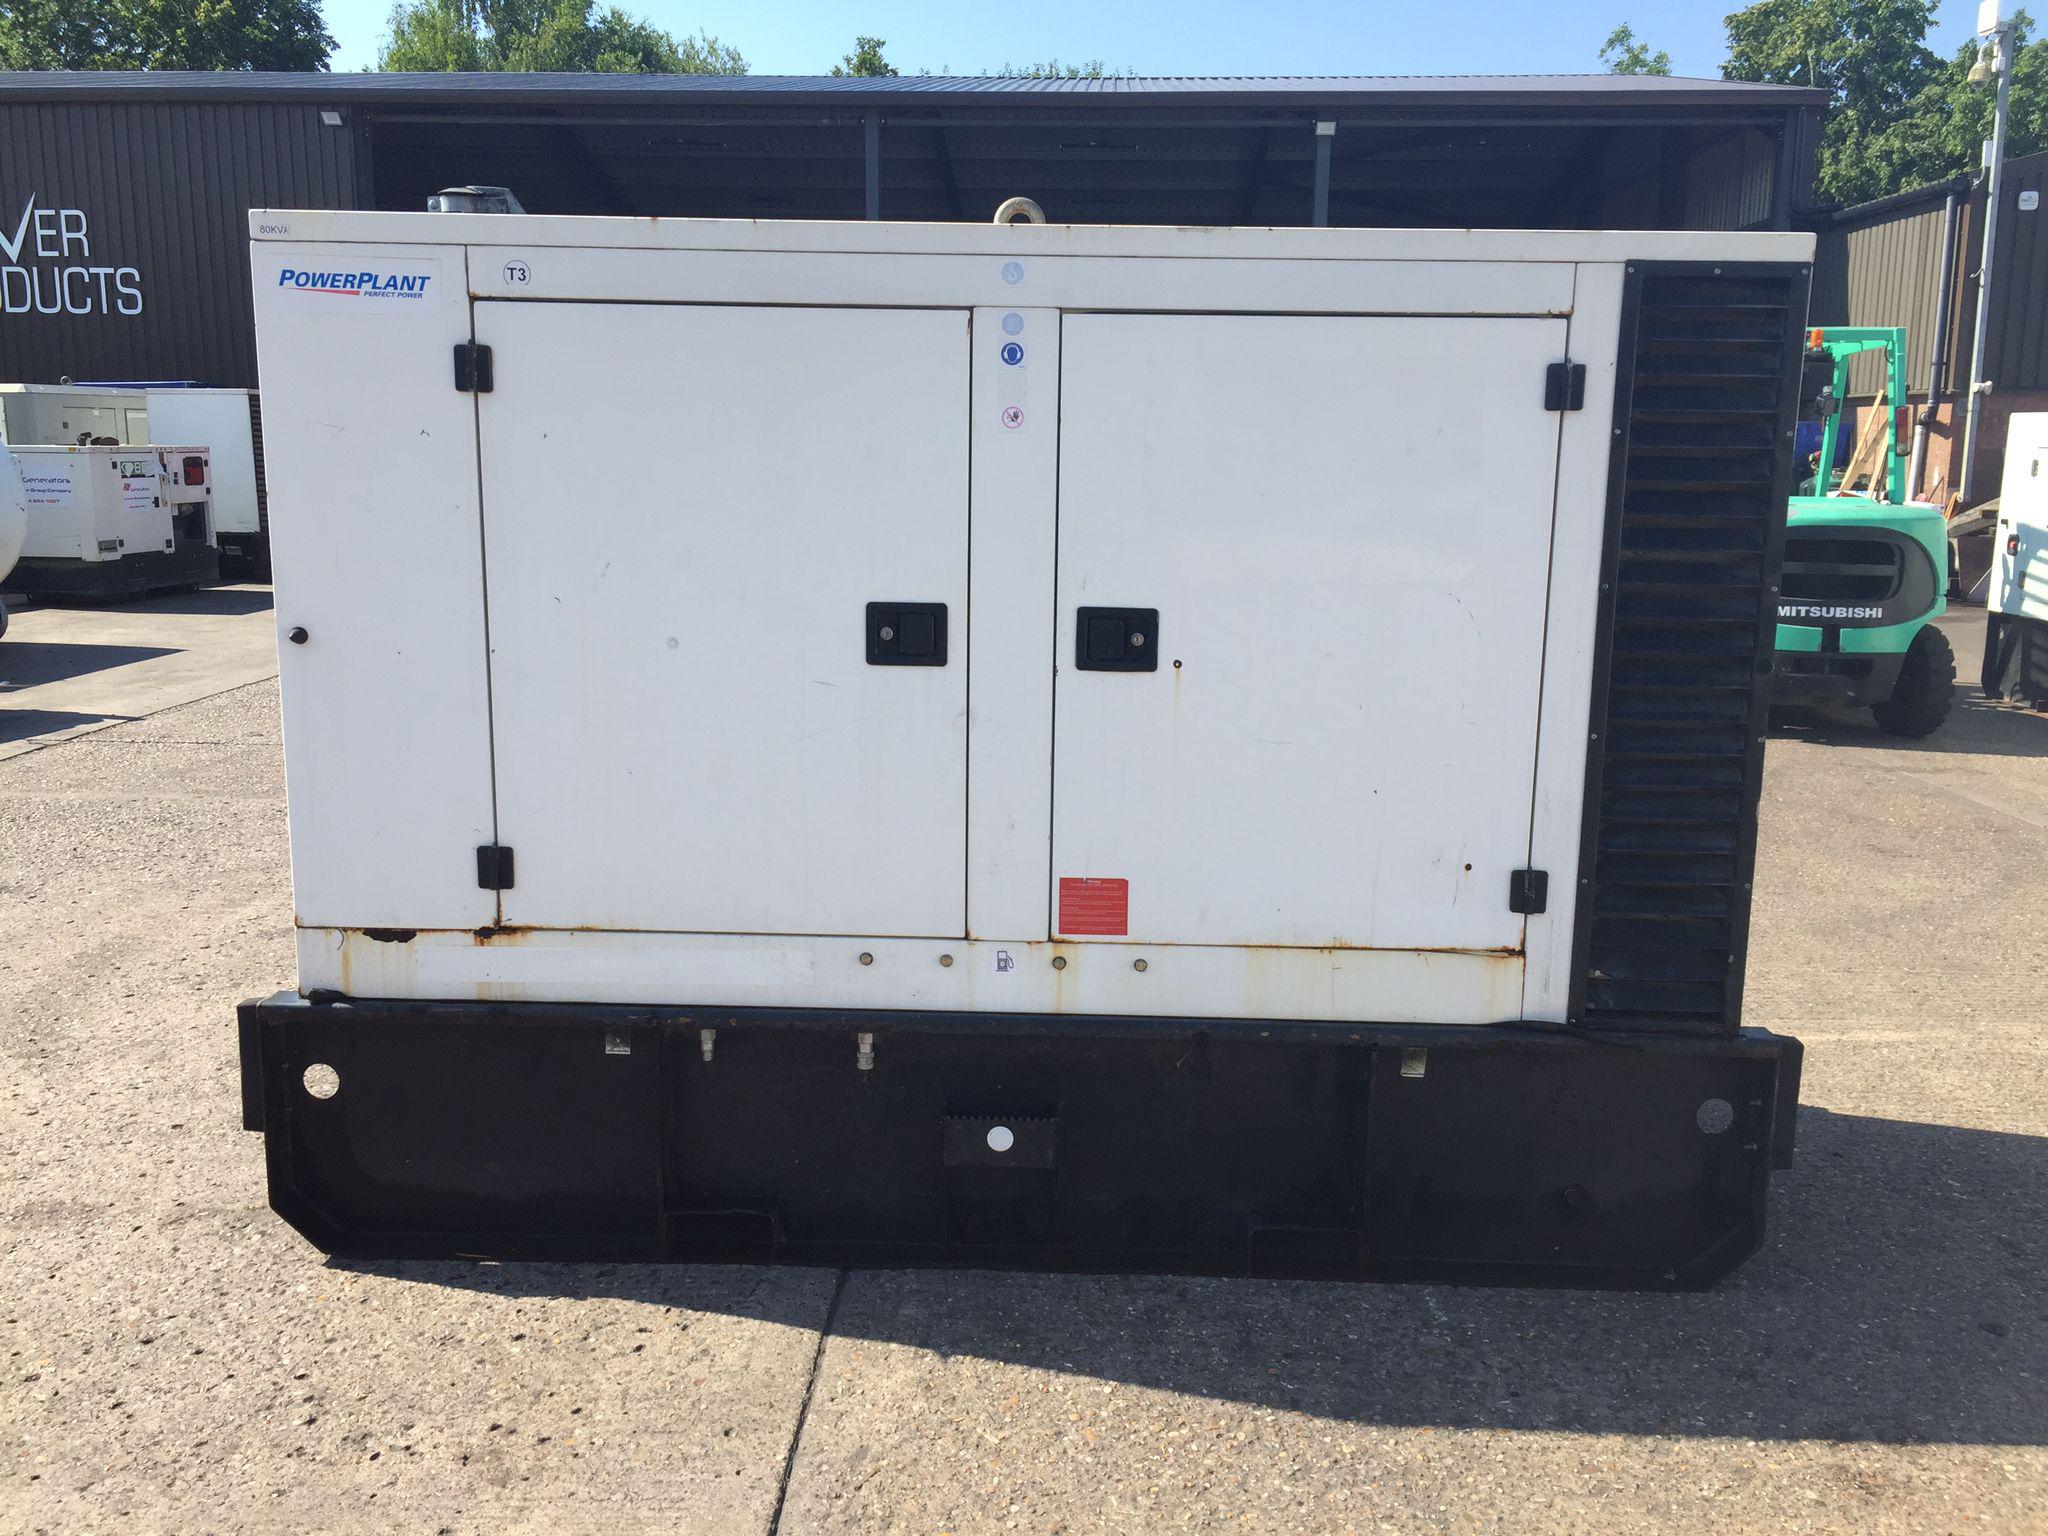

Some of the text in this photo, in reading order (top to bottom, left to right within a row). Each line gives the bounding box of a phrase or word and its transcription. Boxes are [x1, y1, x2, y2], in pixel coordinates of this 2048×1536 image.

[506, 267, 527, 282] T3
[0, 266, 143, 315] DUCTS
[363, 290, 423, 299] PERFECT POWER
[1776, 605, 1883, 619] MITSUBISHI
